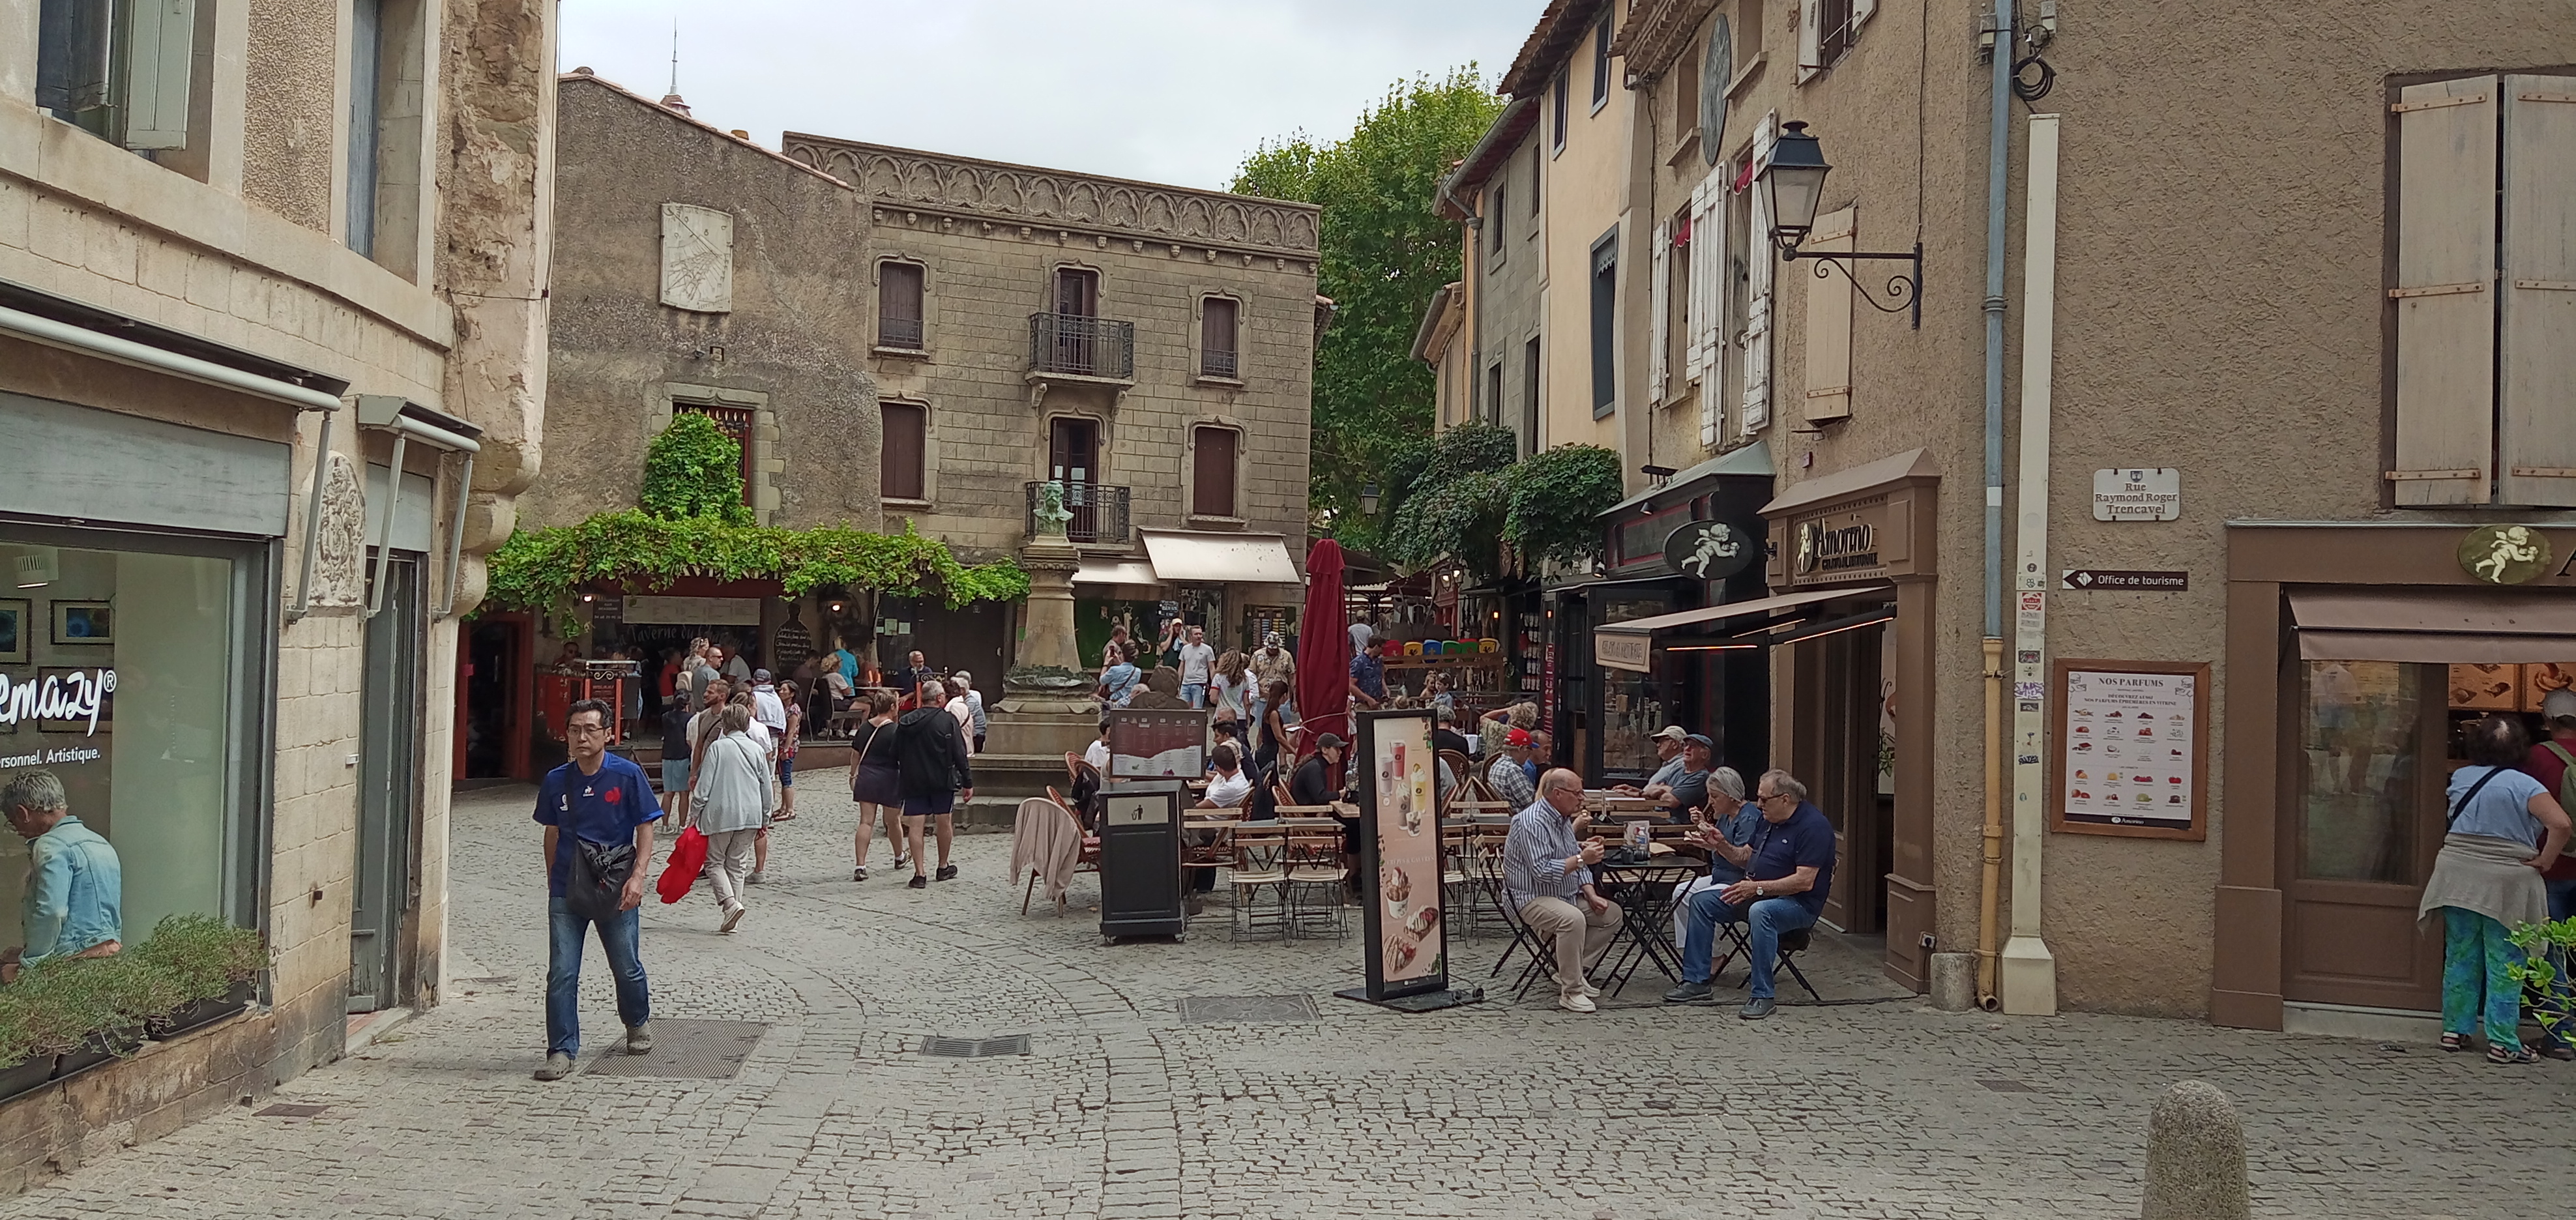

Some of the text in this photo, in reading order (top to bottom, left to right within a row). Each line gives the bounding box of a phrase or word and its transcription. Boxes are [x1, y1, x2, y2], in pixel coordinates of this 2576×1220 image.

[2125, 483, 2146, 491] Rue
[2095, 493, 2177, 504] Raymond Roger
[2106, 504, 2165, 514] Trencavel
[2098, 575, 2184, 585] Office de tourisme
[627, 623, 677, 643] Taverne
[2120, 678, 2164, 687] PARFUMS
[0, 747, 101, 768] rsonnel. Artistique.
